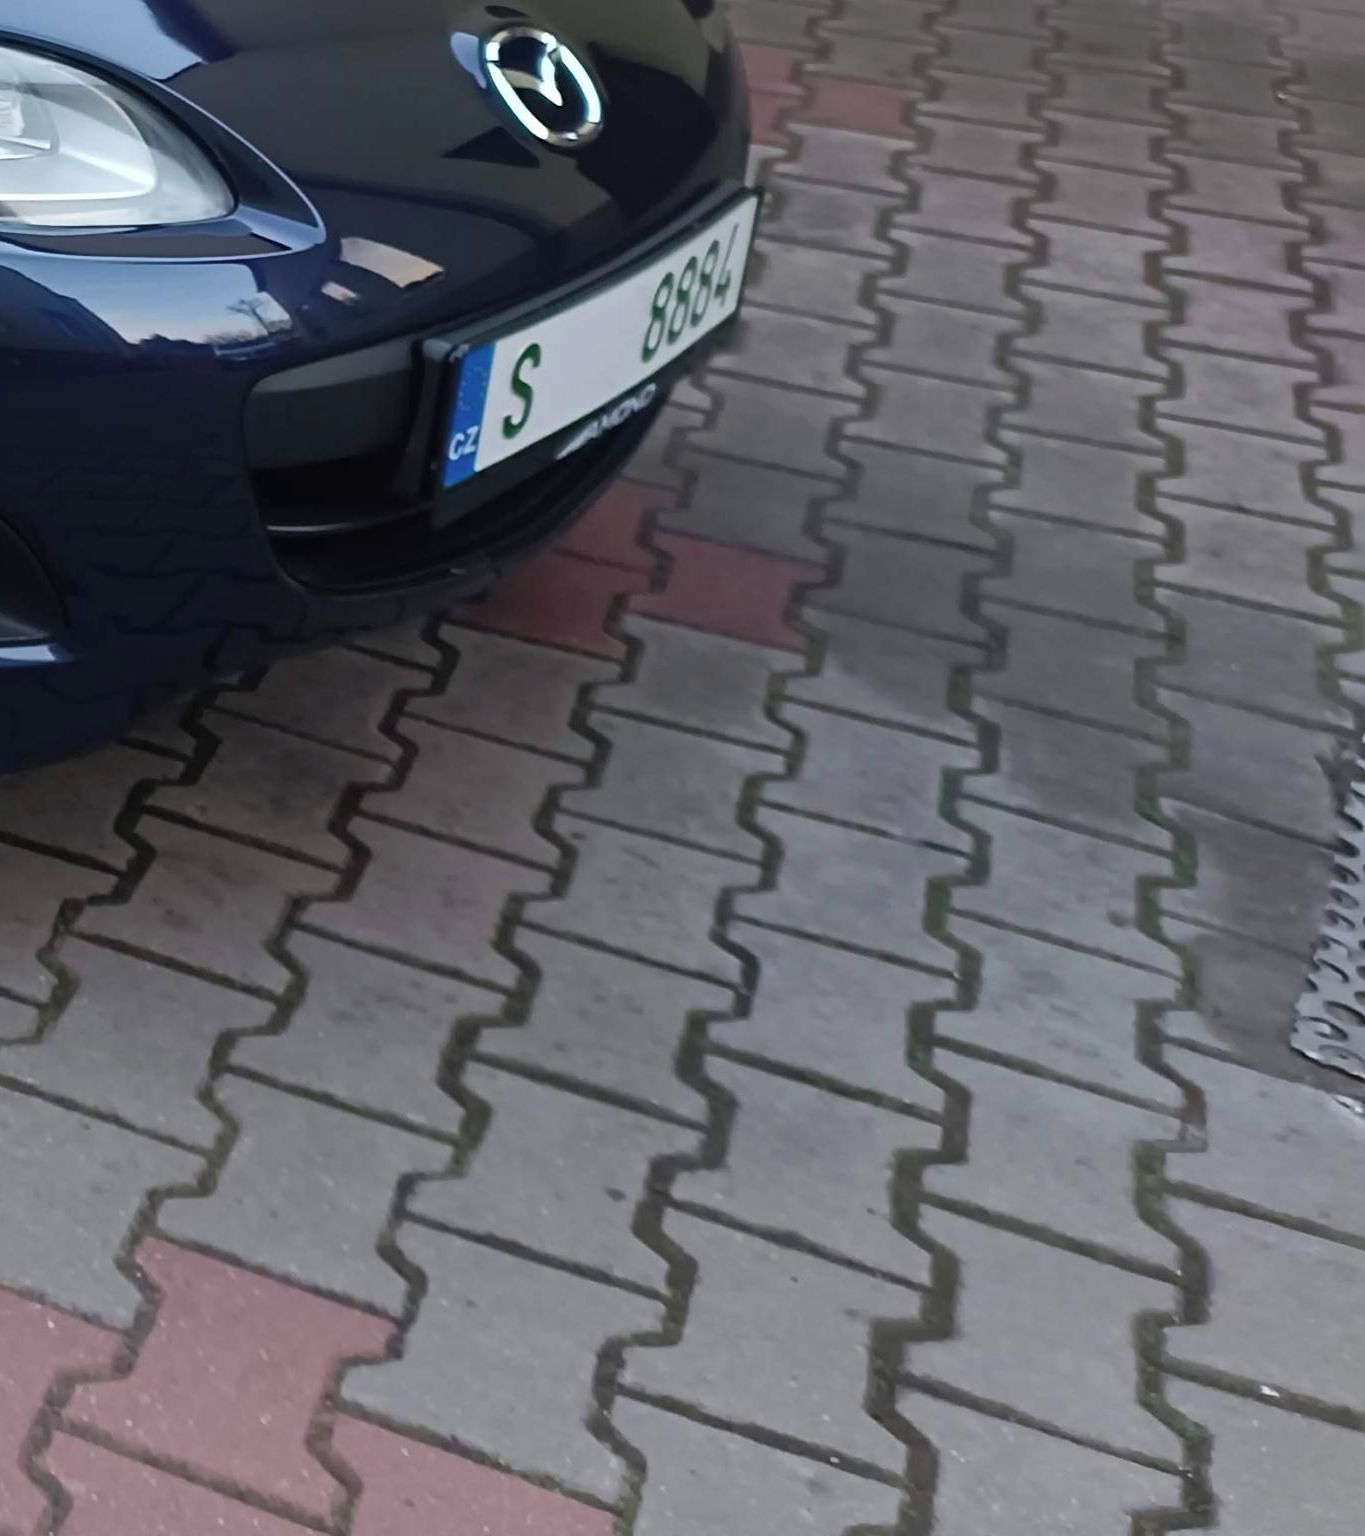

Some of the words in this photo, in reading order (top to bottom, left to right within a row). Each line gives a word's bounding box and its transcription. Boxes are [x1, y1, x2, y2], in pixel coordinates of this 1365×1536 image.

[502, 343, 541, 439] S
[641, 223, 740, 363] 8884
[448, 426, 479, 461] CZ
